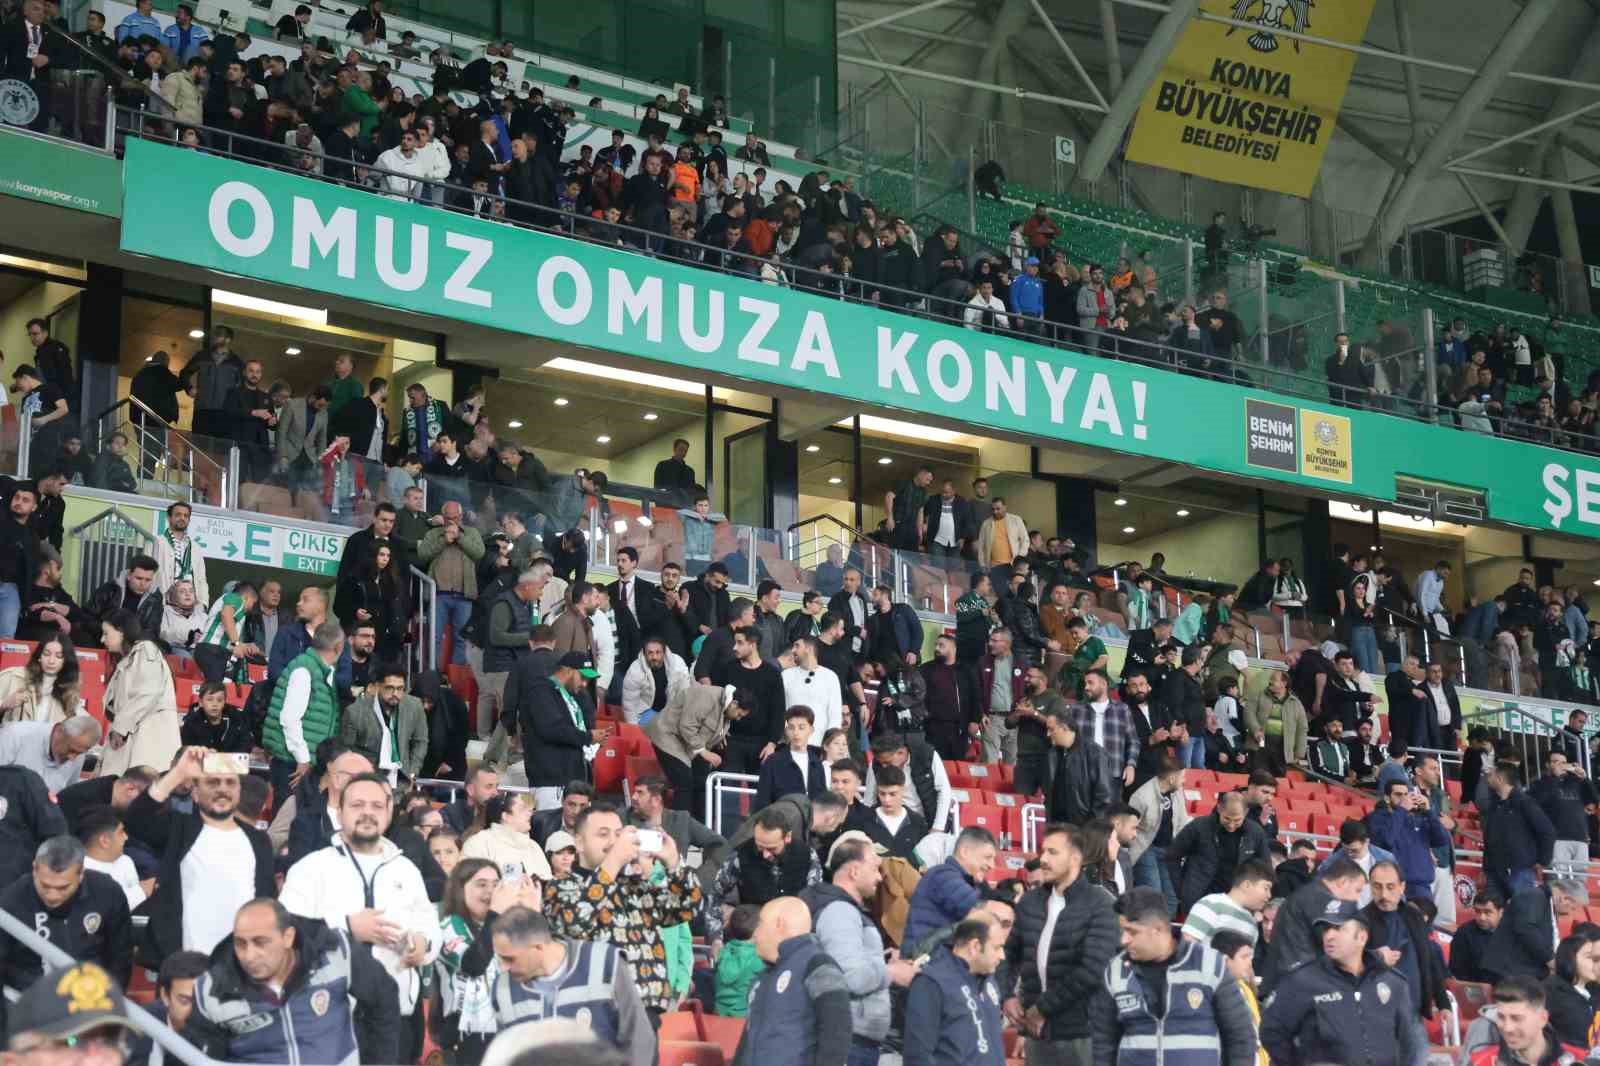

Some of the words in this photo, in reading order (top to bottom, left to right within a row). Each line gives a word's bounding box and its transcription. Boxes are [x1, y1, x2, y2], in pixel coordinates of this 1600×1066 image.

[1209, 57, 1292, 100] KONYA
[1156, 79, 1322, 145] BÜYÜKŞEHİR
[1060, 139, 1072, 156] C
[1181, 125, 1281, 162] BELEDİYESİ
[208, 181, 493, 308] OMUZ
[537, 255, 840, 379] OMUZA
[877, 326, 1148, 440] KONYA!
[245, 523, 272, 562] E
[289, 531, 338, 556] ÇIKIŞ
[298, 556, 328, 573] EXIT
